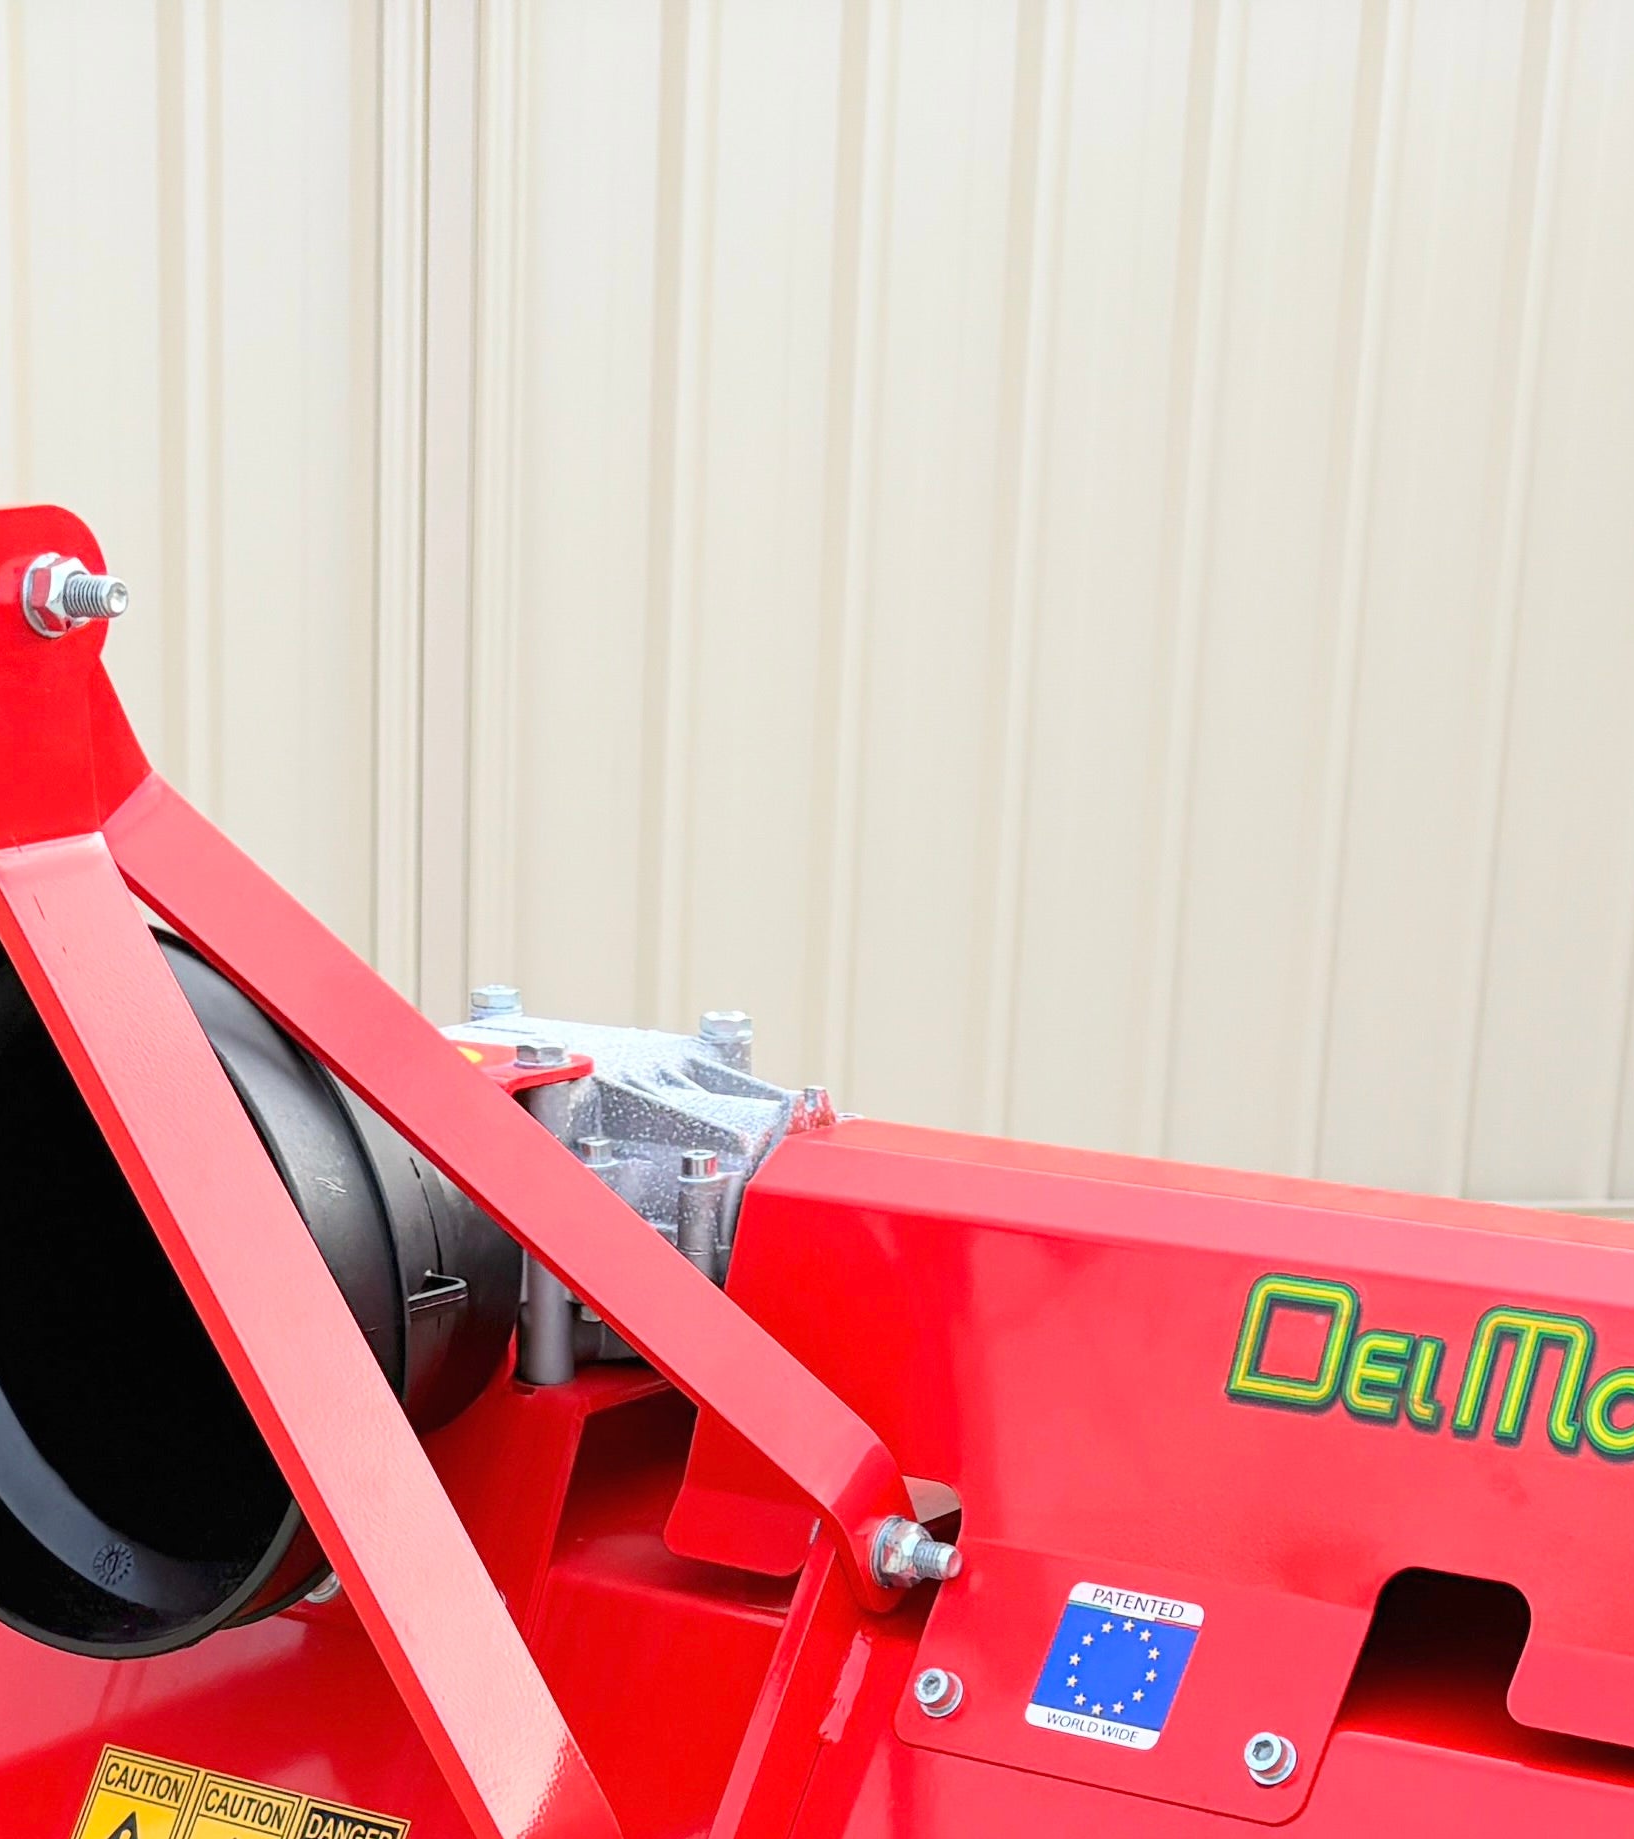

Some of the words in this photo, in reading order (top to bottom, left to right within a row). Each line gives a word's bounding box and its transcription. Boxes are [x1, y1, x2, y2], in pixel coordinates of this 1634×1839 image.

[1092, 1587, 1184, 1619] PATENTED
[1046, 1712, 1099, 1734] WORLD
[1101, 1724, 1139, 1744] WIDE
[105, 1763, 186, 1804] CAUTION
[204, 1788, 288, 1830] CAUTION
